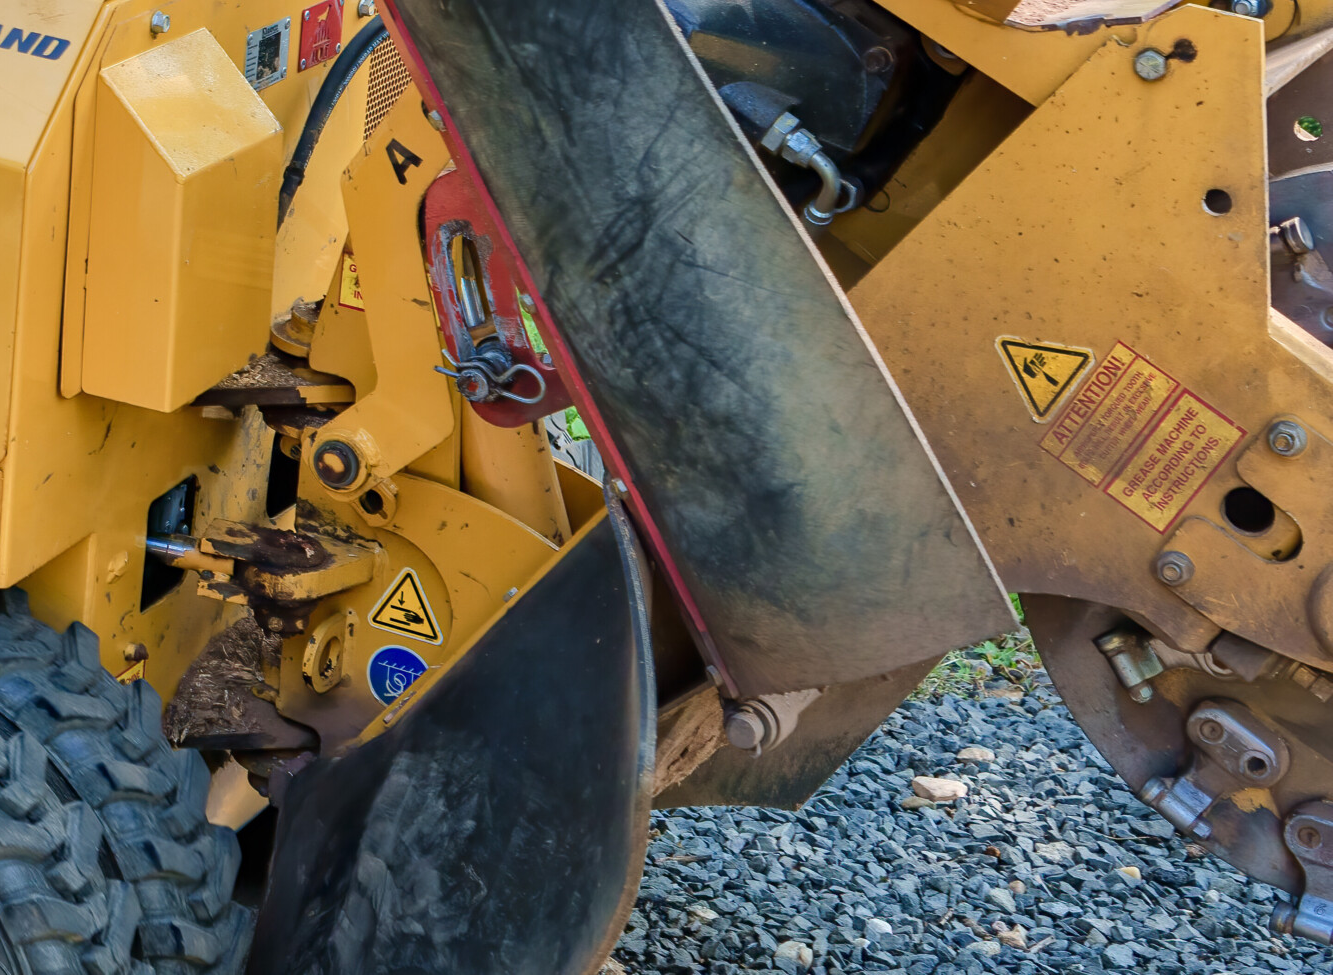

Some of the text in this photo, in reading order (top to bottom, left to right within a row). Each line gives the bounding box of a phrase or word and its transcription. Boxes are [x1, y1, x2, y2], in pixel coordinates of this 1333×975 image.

[385, 137, 423, 185] A
[1049, 354, 1126, 445] ATTENTION!
[1101, 391, 1127, 421] TORQUED
[1123, 370, 1143, 393] TOOTH
[1103, 411, 1125, 436] RESULT
[1120, 406, 1199, 498] GREASE MACHINE
[1140, 422, 1208, 502] ACCORDING TO
[1153, 432, 1222, 512] INSTRUCTIONS.
